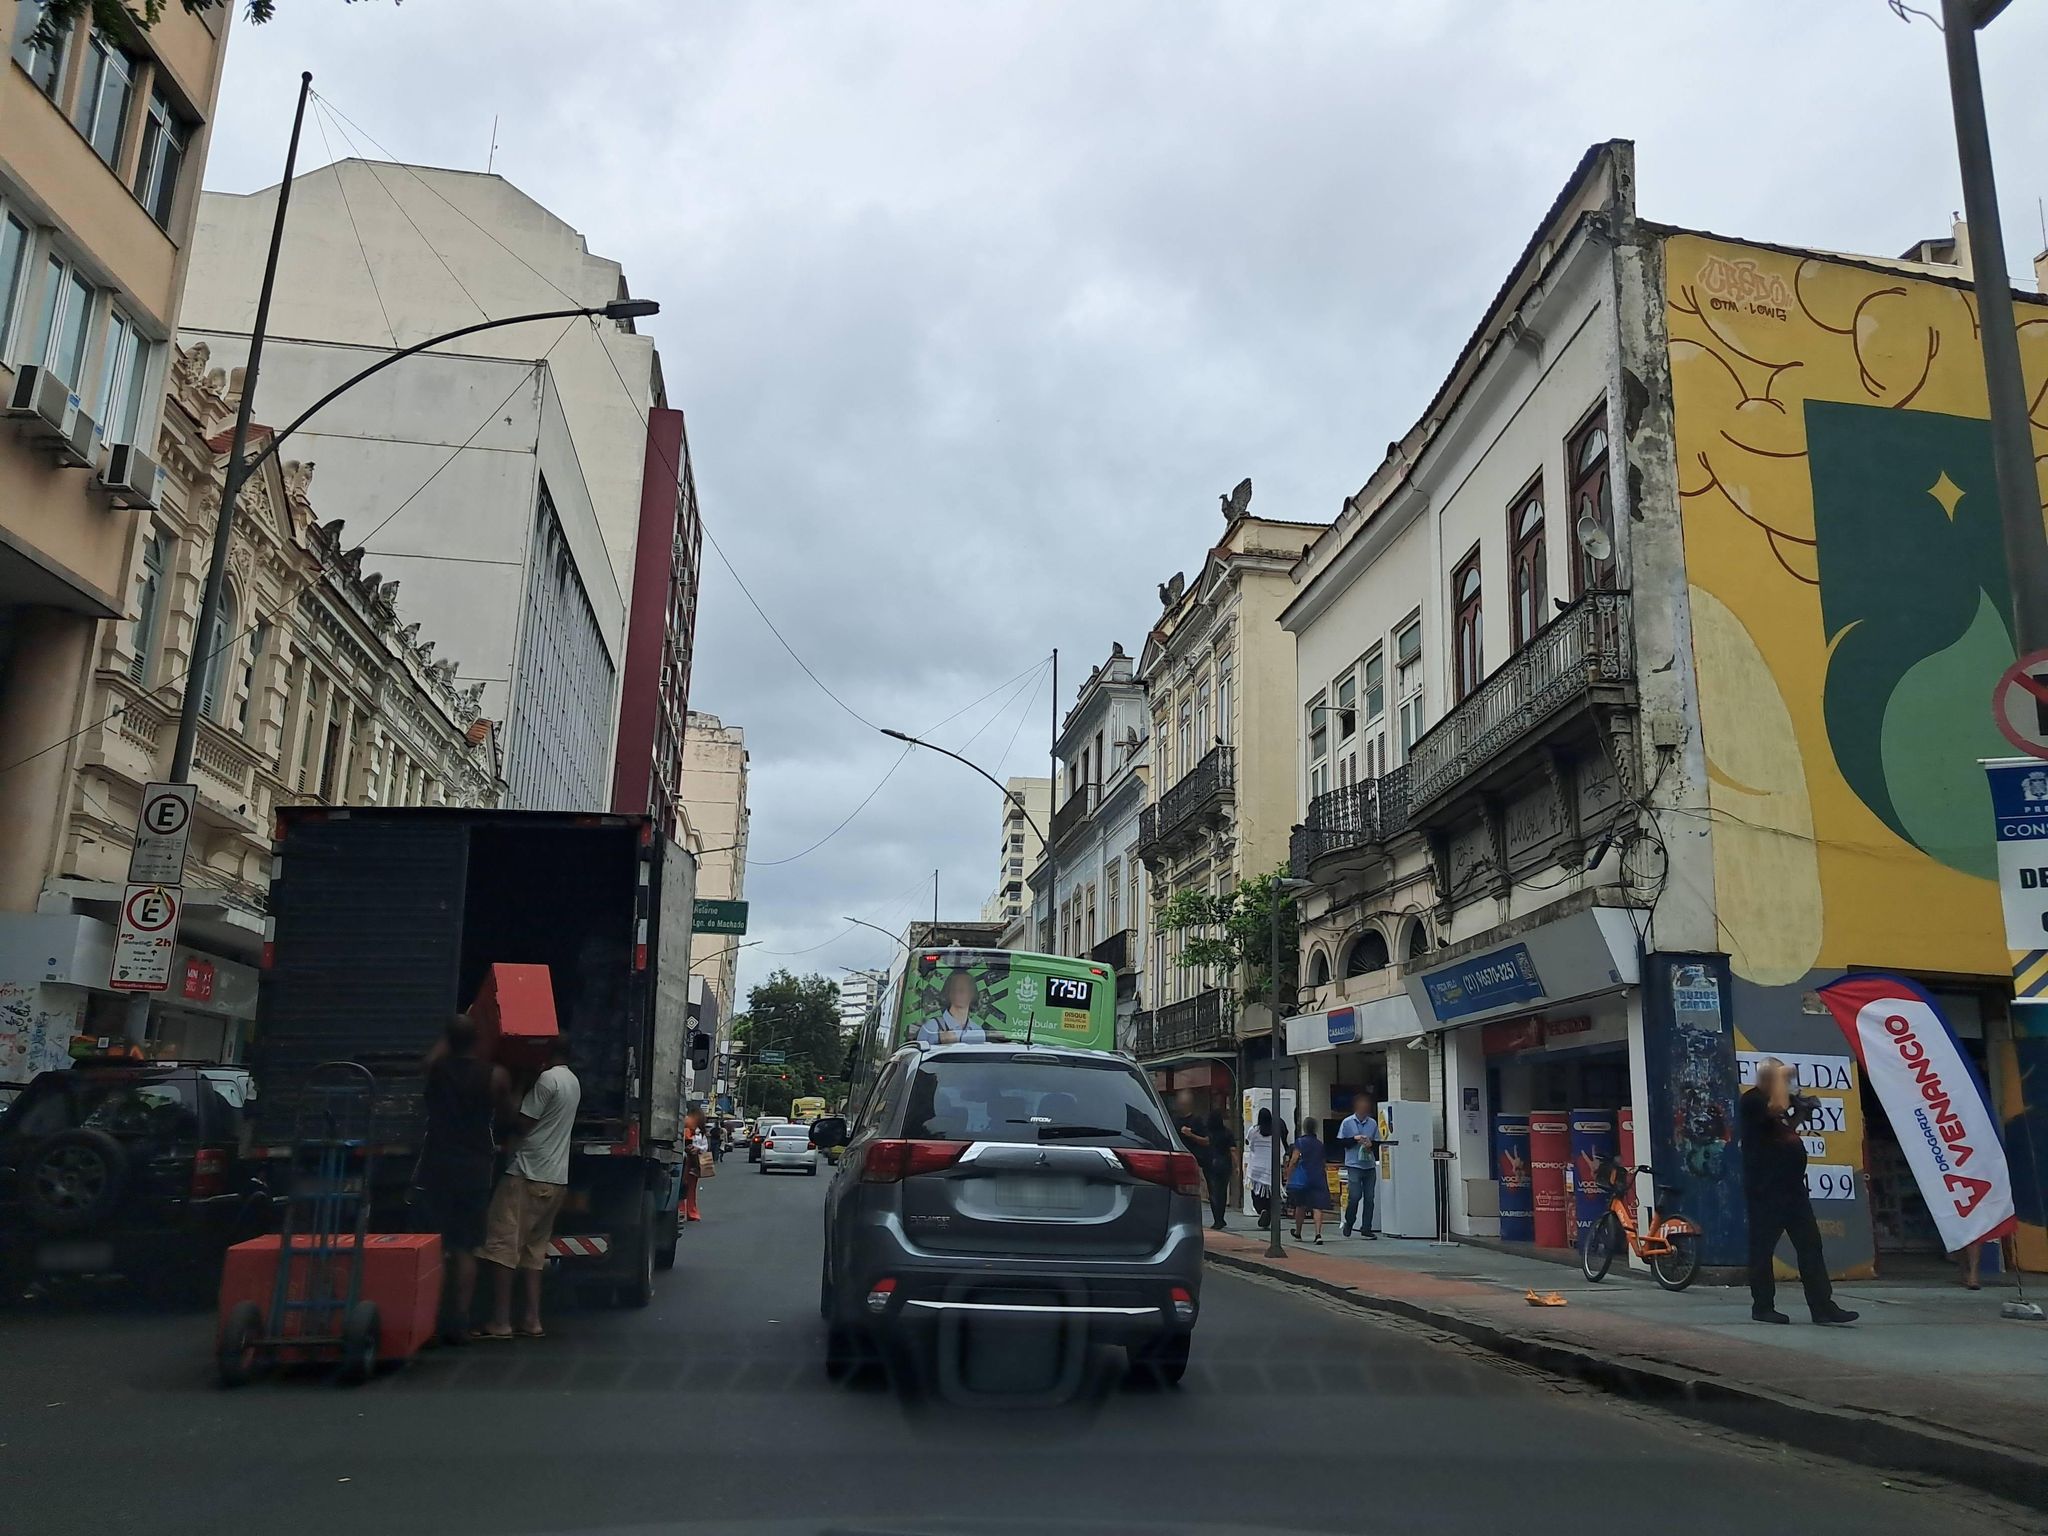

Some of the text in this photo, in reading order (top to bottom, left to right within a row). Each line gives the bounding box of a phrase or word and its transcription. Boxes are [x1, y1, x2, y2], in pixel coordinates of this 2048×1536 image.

[157, 802, 176, 827] E
[2003, 824, 2048, 837] CON
[141, 898, 161, 923] E
[707, 919, 716, 927] do
[717, 920, 745, 929] Machado
[155, 937, 171, 947] 2h
[1050, 978, 1087, 1000] 775D
[1012, 1017, 1058, 1030] Vesibular
[1736, 1060, 1852, 1090] FLDA
[1884, 1014, 1974, 1168] VENANCIO
[1913, 1108, 1950, 1172] DROGARIA
